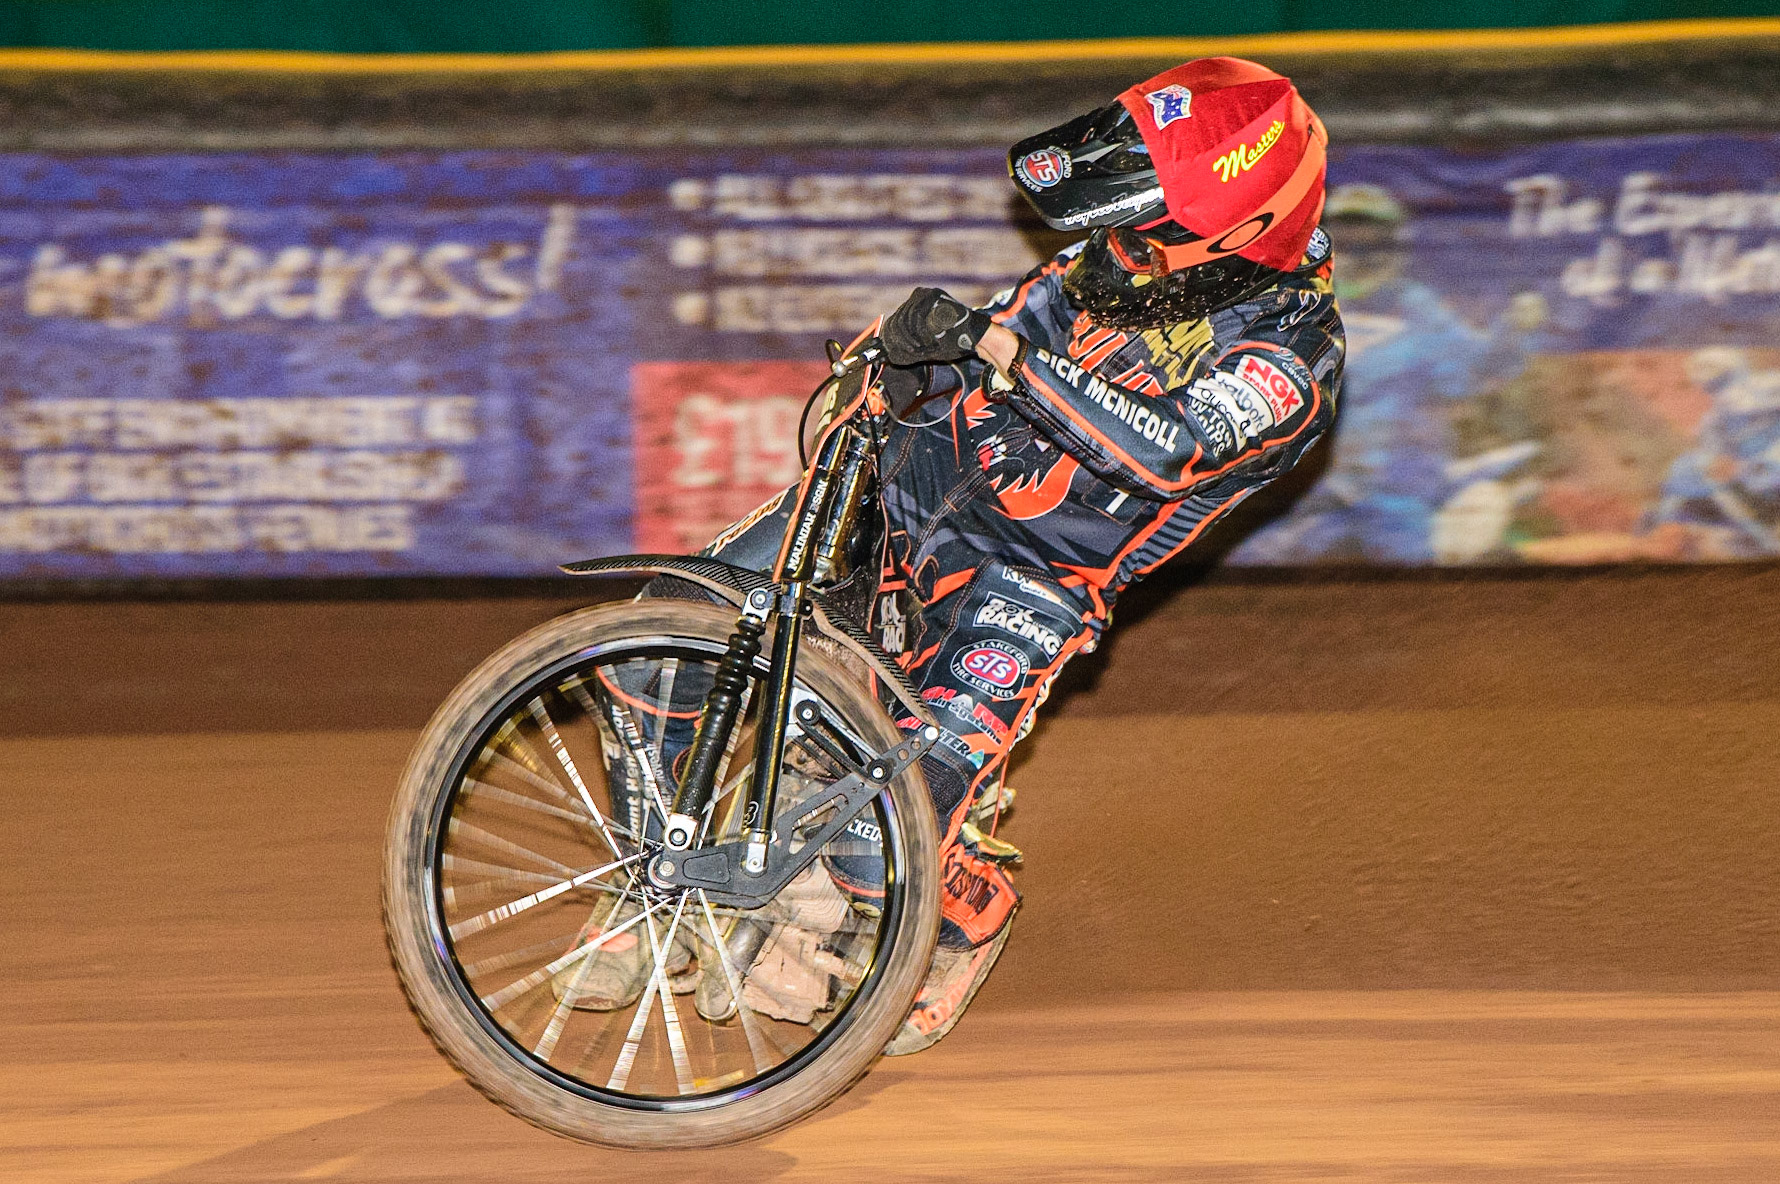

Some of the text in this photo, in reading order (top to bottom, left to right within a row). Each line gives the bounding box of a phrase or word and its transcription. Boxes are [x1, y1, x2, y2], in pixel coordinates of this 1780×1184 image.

[1029, 152, 1059, 181] STS
[1212, 120, 1285, 183] Masters
[1036, 348, 1085, 389] DICK
[1084, 375, 1185, 454] MCNICOLL
[1242, 373, 1272, 401] SPARK
[1244, 357, 1300, 417] NGK
[976, 604, 1062, 656] RACING
[968, 651, 1013, 680] STS
[969, 675, 1016, 698] SERVICES
